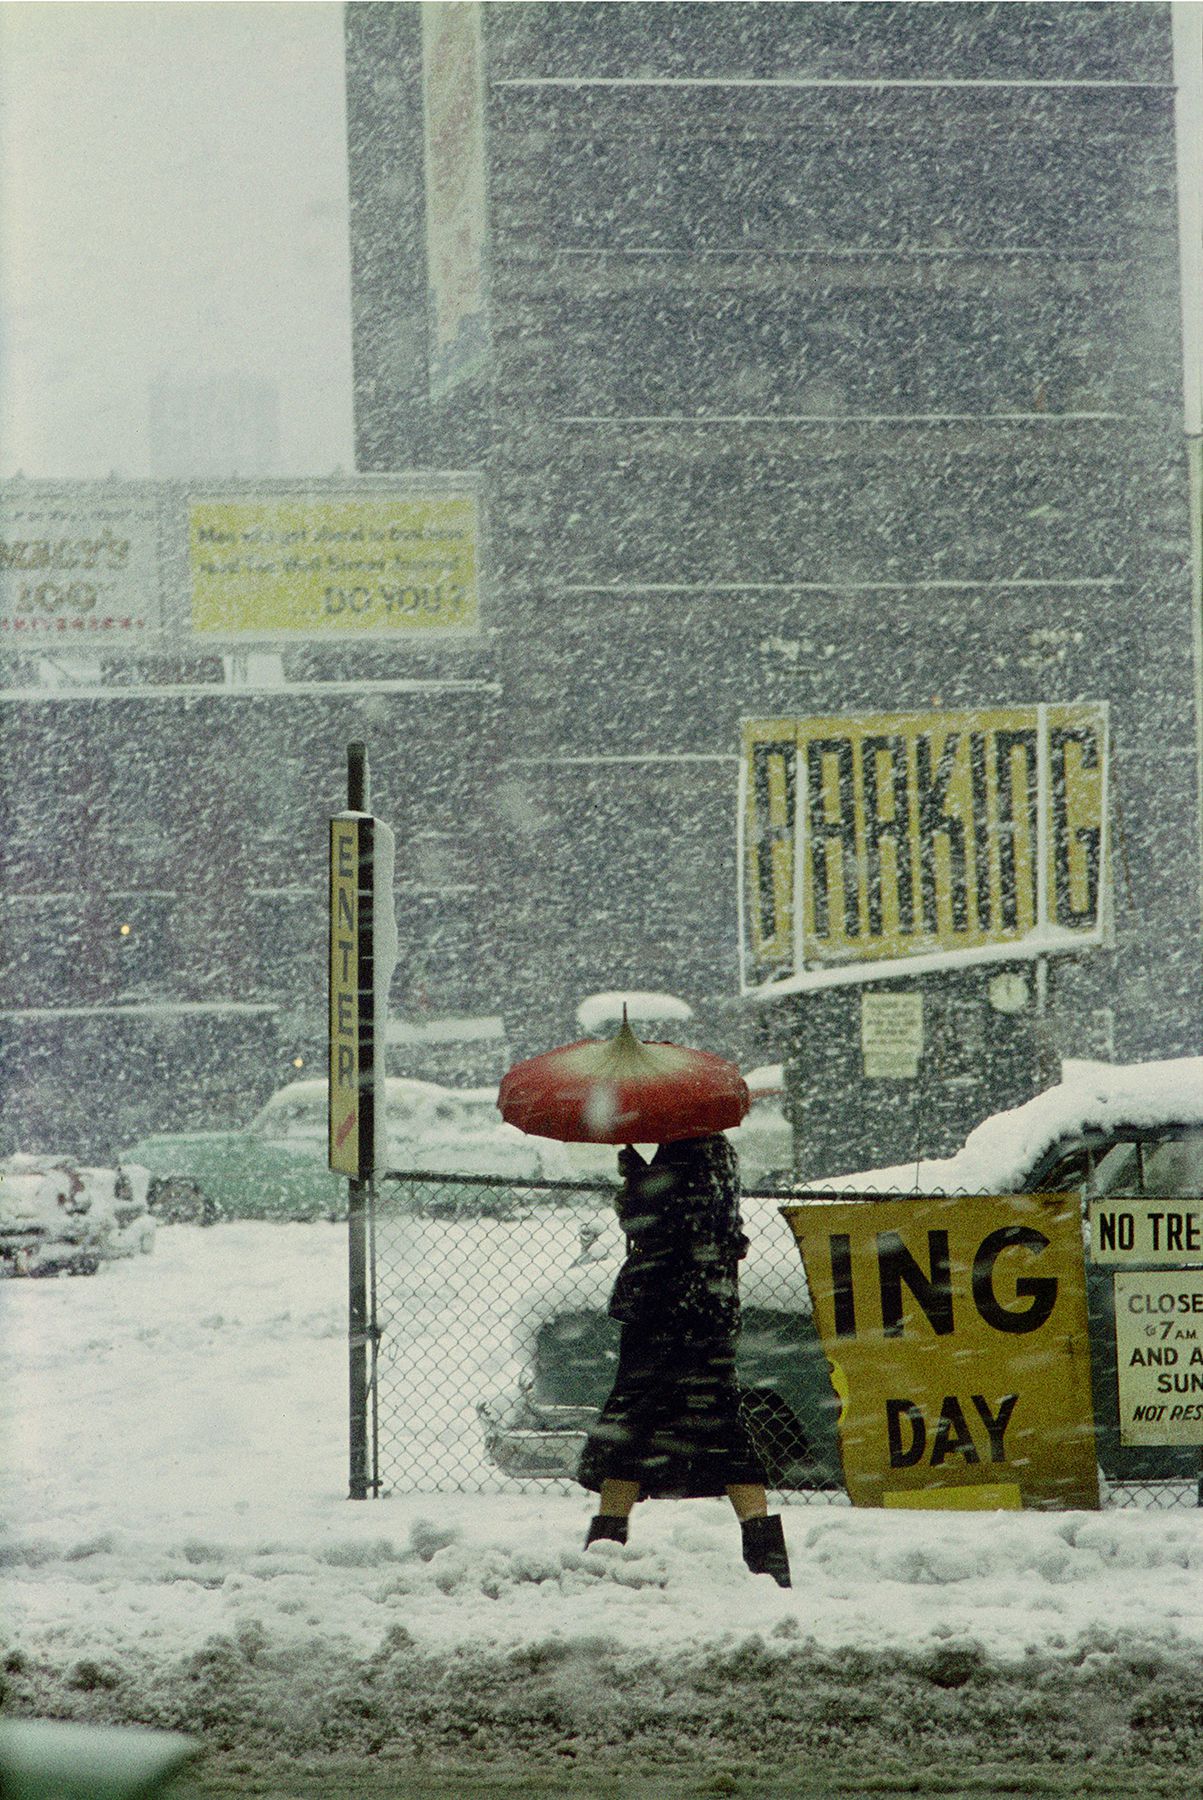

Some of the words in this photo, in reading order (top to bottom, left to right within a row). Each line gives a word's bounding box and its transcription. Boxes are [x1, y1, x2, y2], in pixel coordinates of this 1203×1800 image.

[752, 726, 1100, 940] PARKING
[338, 835, 355, 1088] ENTER
[1099, 1212, 1134, 1251] NO
[1147, 1212, 1201, 1251] TRE
[829, 1225, 1059, 1339] ING
[1128, 1294, 1203, 1314] CLOSE
[1159, 1321, 1174, 1340] 7
[1129, 1347, 1179, 1367] AND
[1189, 1347, 1203, 1367] A
[1157, 1373, 1203, 1393] SUN
[1133, 1405, 1168, 1422] NOT
[1170, 1405, 1203, 1422] RES
[885, 1393, 1020, 1469] DAY
